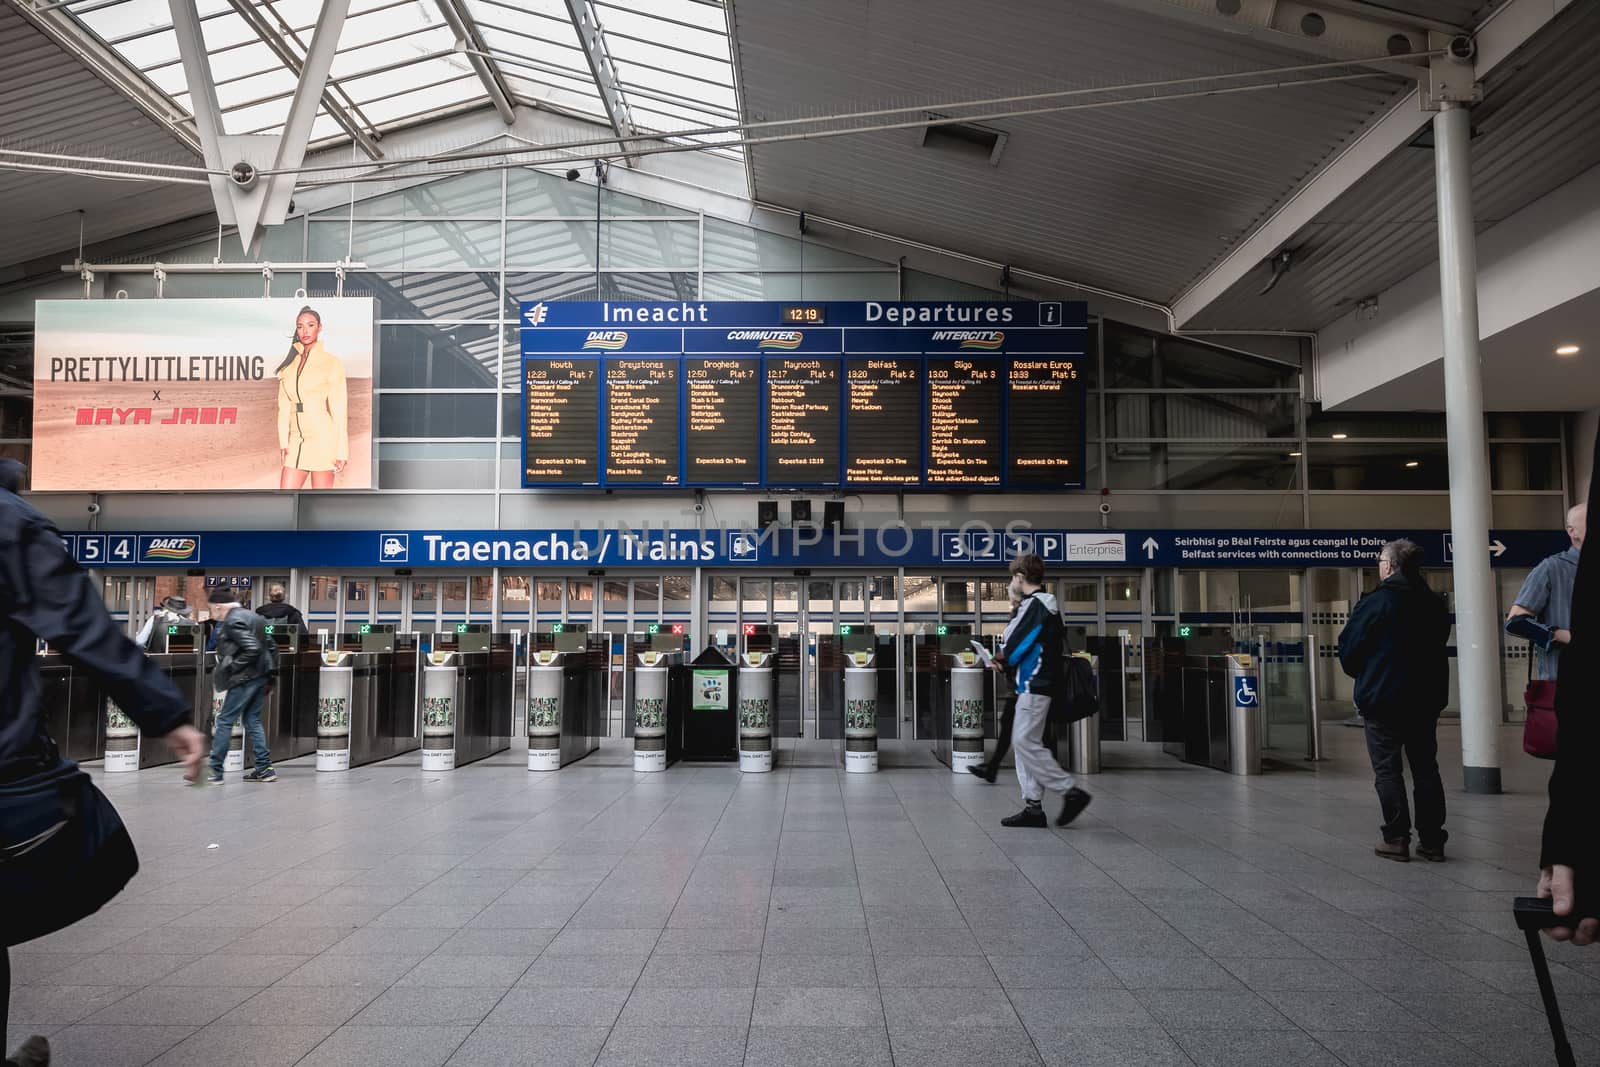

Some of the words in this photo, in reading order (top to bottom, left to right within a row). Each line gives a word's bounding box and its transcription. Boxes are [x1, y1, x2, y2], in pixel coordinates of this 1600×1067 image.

[603, 302, 708, 322] Imeacht
[866, 302, 1013, 326] Departures
[587, 331, 620, 341] DART
[727, 330, 794, 341] COMMUTER
[932, 331, 996, 341] INTERCITY
[51, 356, 264, 382] PRETTYLITTLETHING
[550, 361, 572, 370] Howth
[619, 361, 664, 370] Greystones
[704, 361, 739, 370] Drogheda
[784, 361, 820, 370] Maynooth
[868, 361, 897, 370] Belfast
[954, 361, 972, 370] Sligo
[1014, 361, 1047, 370] Rosslare
[1050, 361, 1072, 370] Europ
[570, 370, 586, 378] Plat
[588, 370, 593, 378] 7
[650, 370, 665, 378] Plat
[668, 370, 673, 378] 5
[730, 370, 746, 378] Plat
[749, 370, 754, 378] 7
[810, 370, 826, 378] Plat
[829, 370, 834, 378] 4
[890, 370, 907, 378] Plat
[910, 370, 915, 378] 2
[971, 370, 988, 378] Plat
[990, 370, 996, 378] 3
[1052, 370, 1068, 378] Plat
[1071, 370, 1076, 378] 5
[76, 408, 152, 425] MAYA
[161, 408, 238, 424] JAMA
[1218, 538, 1229, 548] go
[1254, 537, 1286, 546] Feirste
[1288, 538, 1311, 548] agus
[1313, 537, 1348, 548] ceangal
[1350, 537, 1359, 546] le
[1361, 537, 1386, 546] Doire
[86, 539, 99, 559] 5
[114, 539, 130, 559] 4
[149, 538, 185, 549] DART
[423, 533, 589, 562] Traenacha
[624, 534, 716, 561] Trains
[950, 538, 963, 557] 3
[982, 538, 995, 557] 2
[1012, 538, 1023, 555] 1
[1043, 538, 1057, 557] P
[1069, 544, 1122, 556] Enterprise
[1182, 550, 1215, 559] Belfast
[1218, 550, 1257, 559] services
[1259, 550, 1279, 559] with
[1282, 550, 1338, 559] connections
[1341, 550, 1351, 559] to
[1354, 550, 1380, 561] Derry
[209, 577, 216, 585] 7
[231, 577, 238, 585] 5
